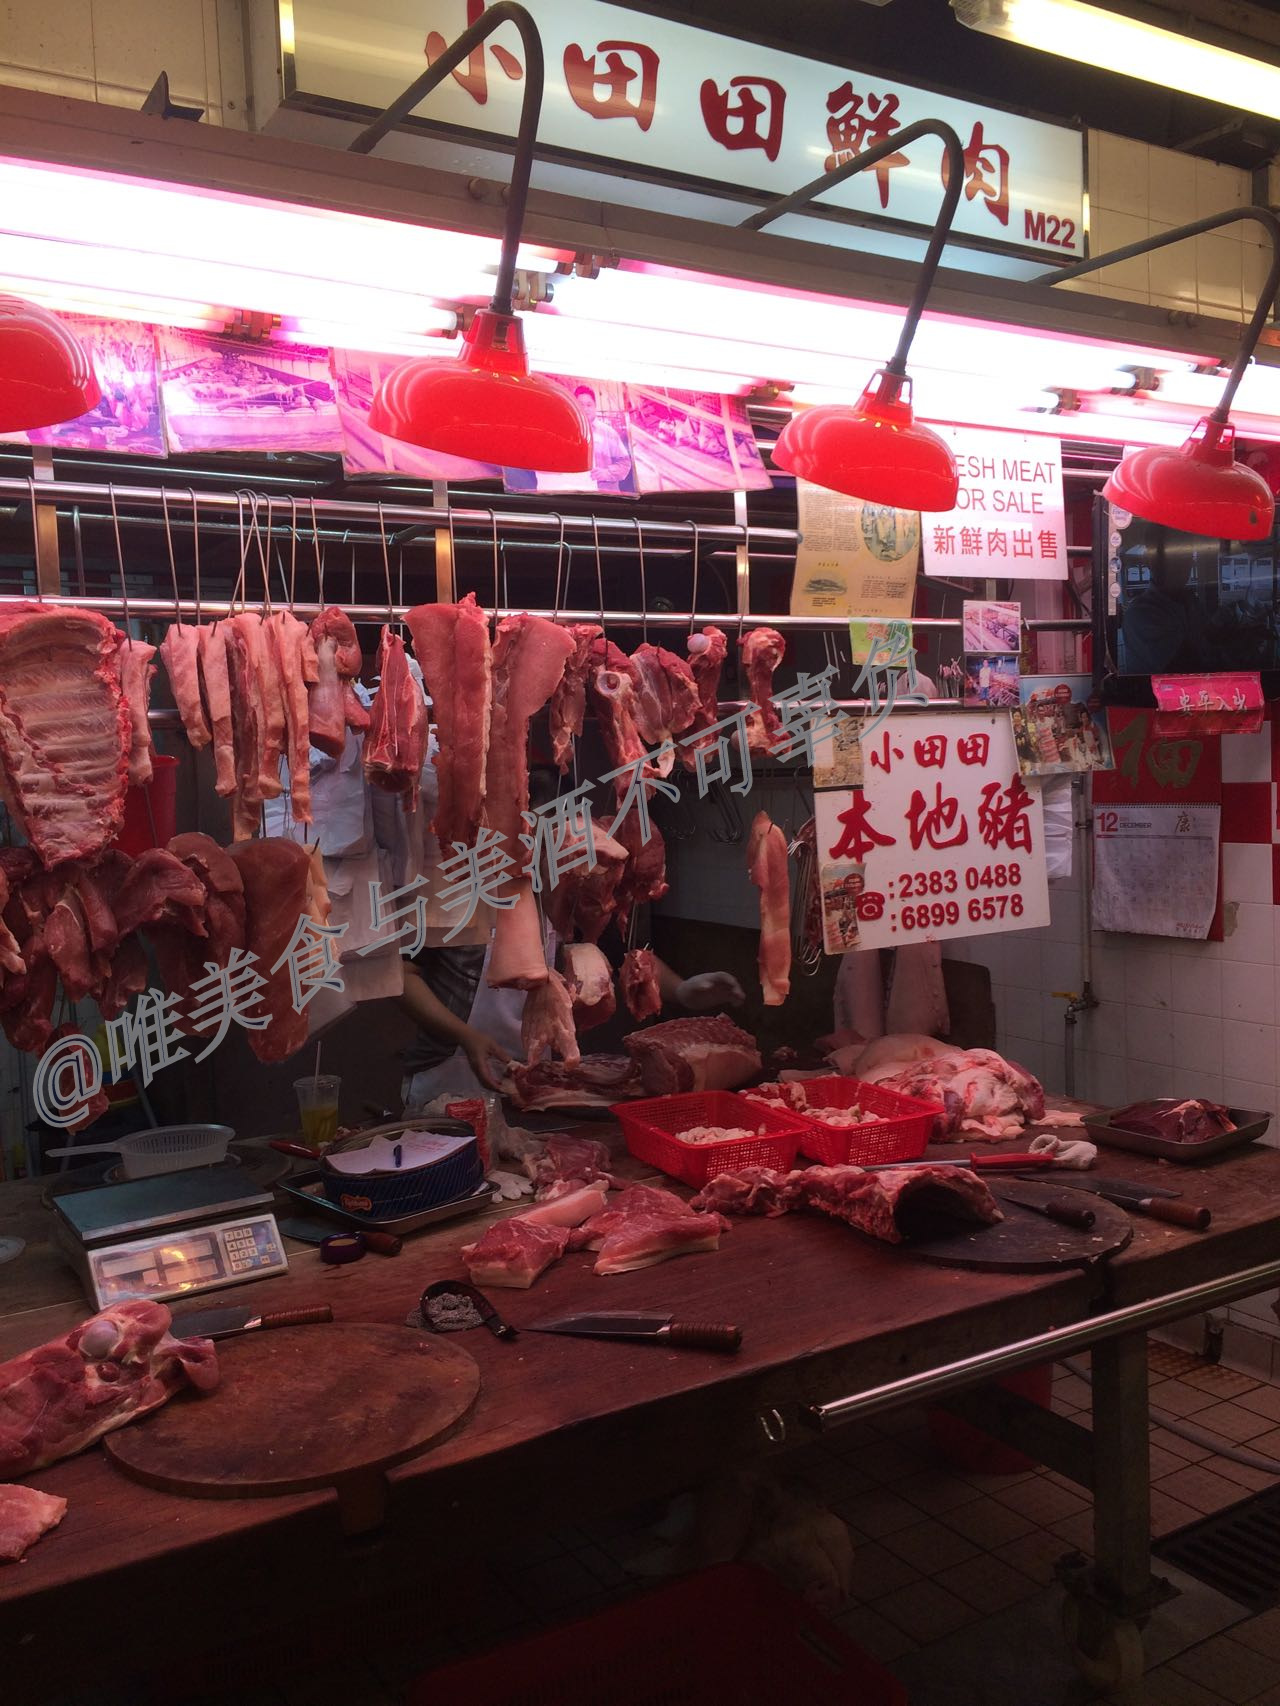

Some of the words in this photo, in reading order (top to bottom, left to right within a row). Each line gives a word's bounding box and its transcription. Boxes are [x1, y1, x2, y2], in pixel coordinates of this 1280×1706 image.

[424, 0, 1010, 226] 小田田鮮肉
[1024, 208, 1075, 249] M22
[954, 455, 996, 479] ESH
[1002, 458, 1056, 484] MEAT
[956, 487, 987, 511] OR
[992, 489, 1044, 514] SALE
[933, 524, 1058, 560] 新鮮肉出售
[870, 731, 990, 773] 小田田
[828, 772, 1035, 863] 本地豬
[1096, 811, 1119, 833] 12
[965, 862, 1021, 891] 0488
[967, 893, 1024, 922] 6578
